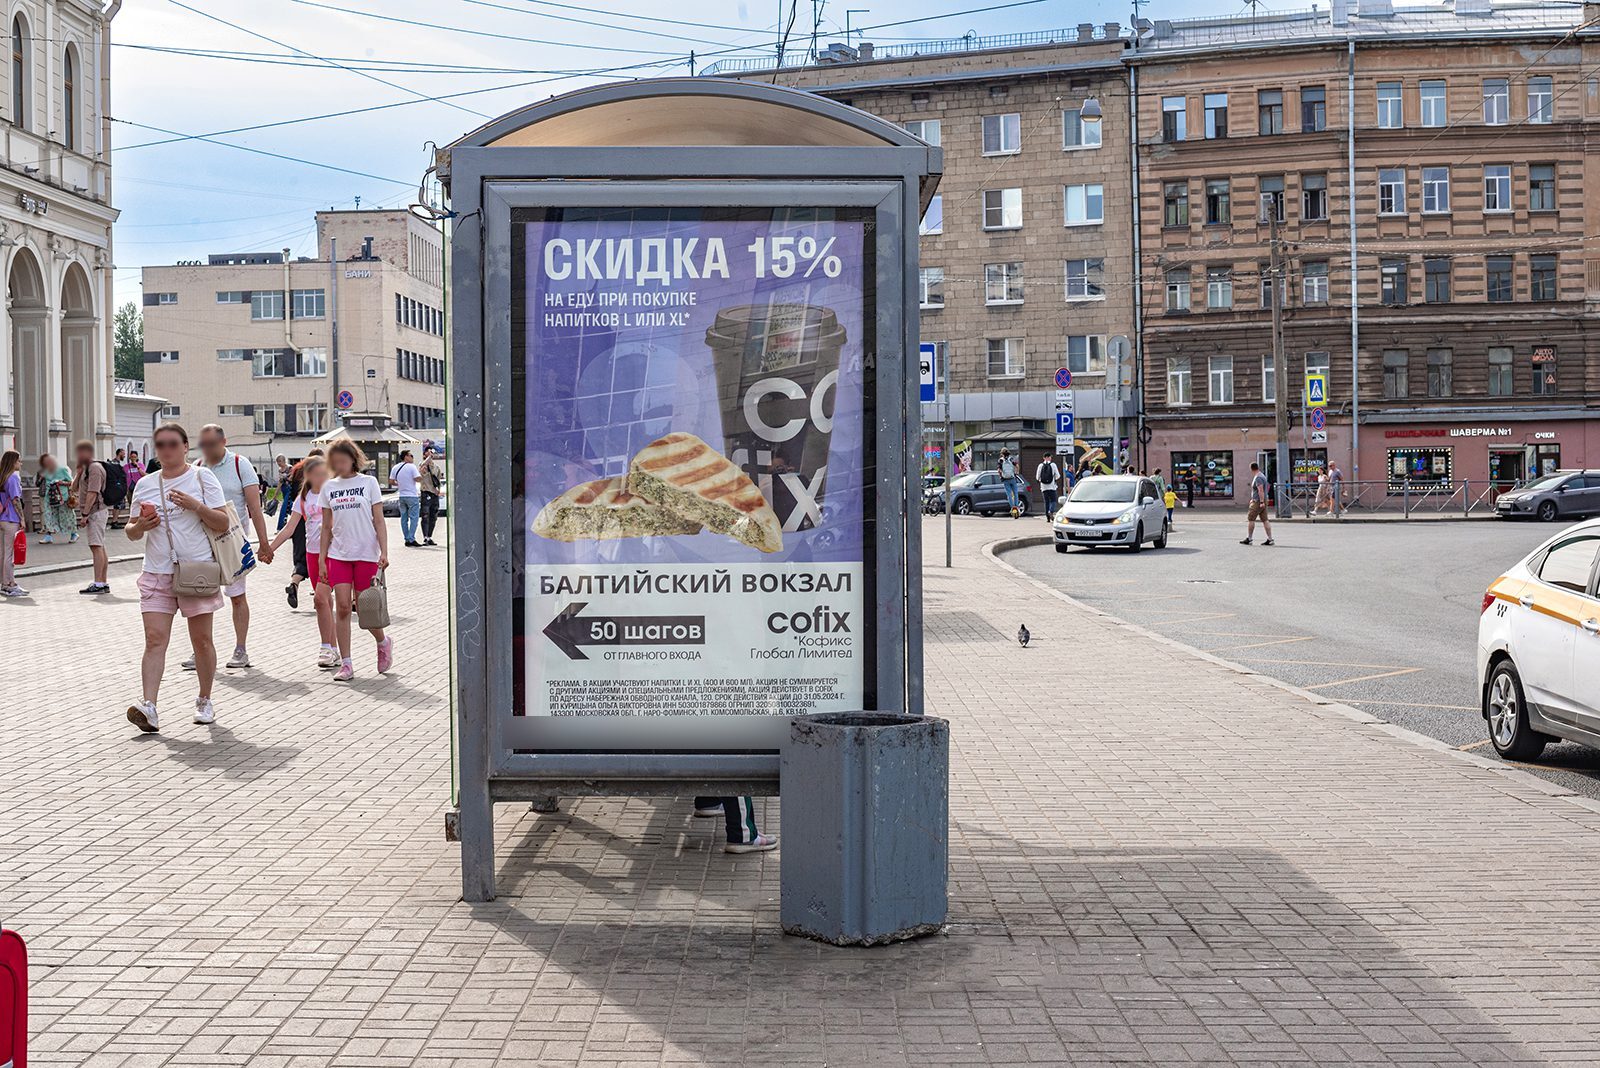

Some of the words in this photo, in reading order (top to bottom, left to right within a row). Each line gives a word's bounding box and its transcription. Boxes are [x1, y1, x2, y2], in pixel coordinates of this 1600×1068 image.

[544, 237, 730, 286] СКИДКА
[747, 236, 842, 278] 15%
[345, 270, 371, 278] БАНИ
[545, 293, 564, 307] НА
[567, 293, 594, 308] ЕДУ
[599, 292, 627, 306] ПРИ
[633, 292, 697, 306] ПОКУПКЕ
[545, 313, 619, 327] НАПИТКОВ
[624, 313, 631, 326] L
[636, 312, 665, 326] ИЛИ
[1061, 414, 1071, 432] P
[1450, 428, 1496, 436] ШАВЕРМА
[1498, 428, 1512, 436] №1
[330, 490, 345, 499] NEW
[346, 487, 364, 497] YORK
[540, 569, 731, 595] БАЛТИЙСКИЙ
[742, 573, 852, 593] ВОКЗАЛ
[767, 605, 852, 634] cofix
[590, 621, 617, 640] 50
[624, 624, 701, 640] шагов
[603, 651, 616, 660] ОТ
[618, 651, 668, 660] ГЛАВНОГО
[669, 651, 701, 661] ВХОДА
[750, 647, 794, 659] Глобал
[797, 648, 852, 659] Лимитед
